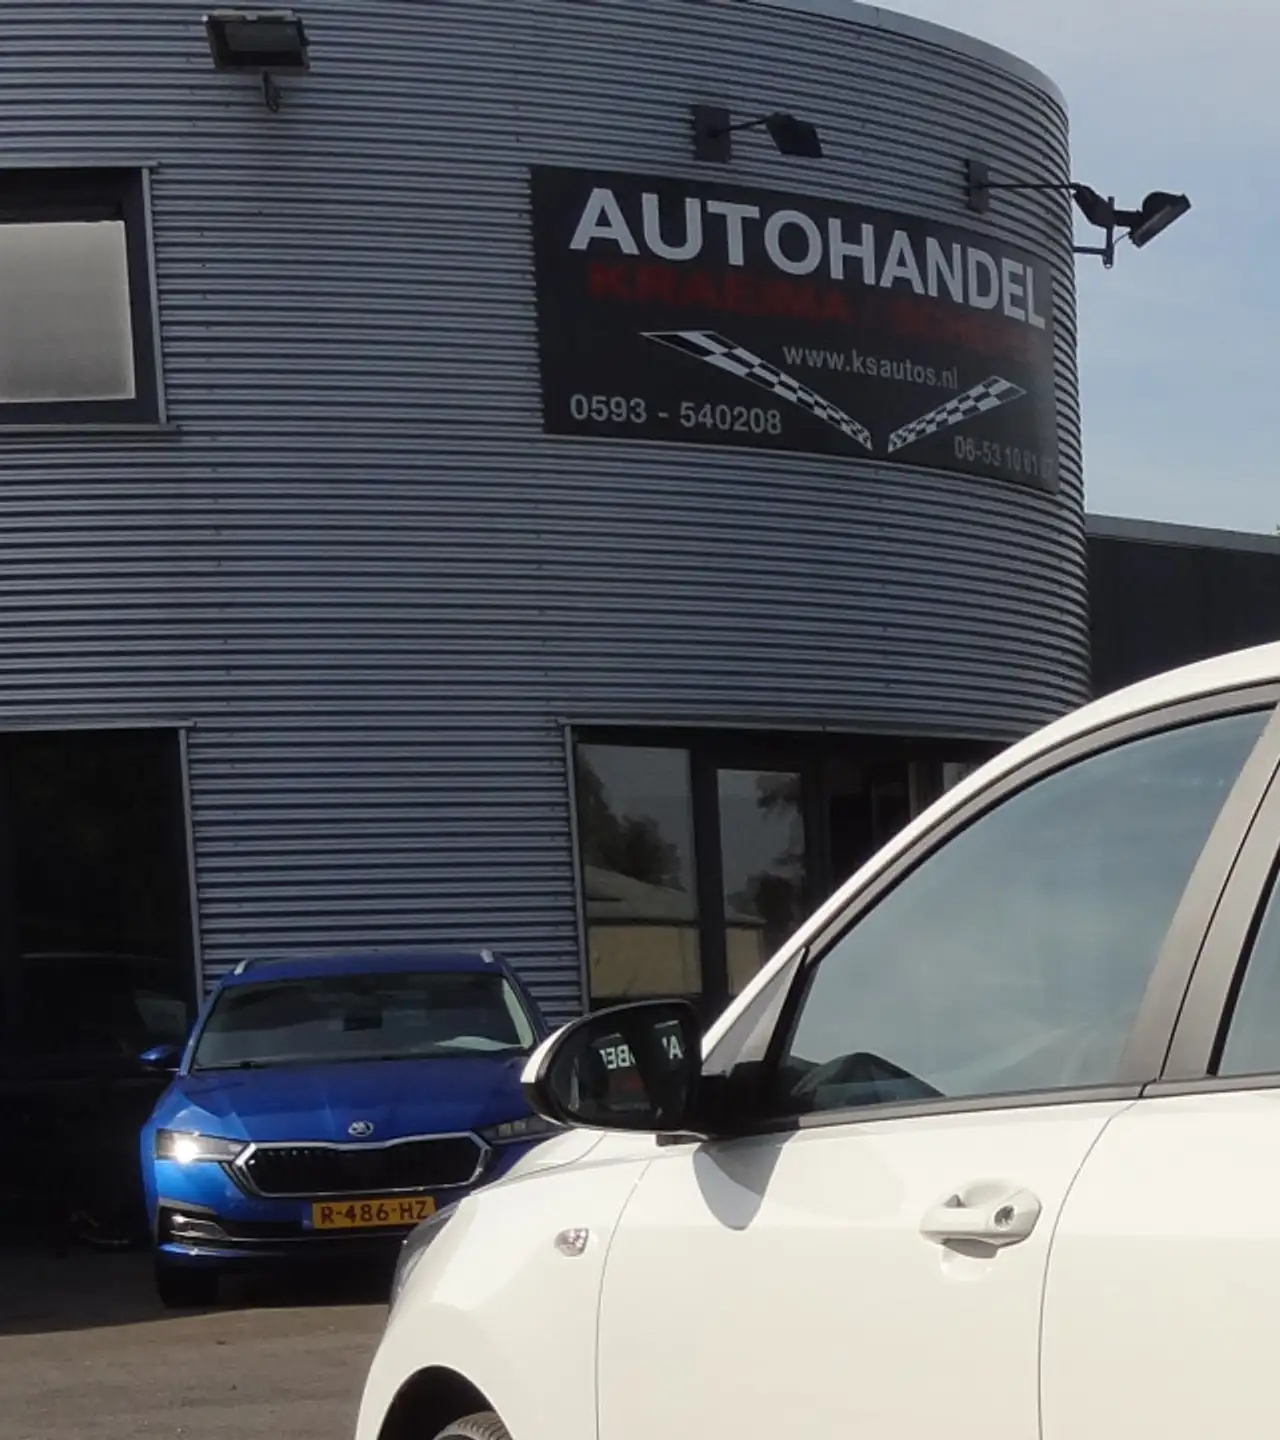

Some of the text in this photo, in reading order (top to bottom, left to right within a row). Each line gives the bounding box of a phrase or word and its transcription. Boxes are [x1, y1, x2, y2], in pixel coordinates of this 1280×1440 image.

[569, 187, 1046, 329] AUTOHANDEL
[782, 344, 958, 390] www.ksautos.nl
[569, 393, 648, 424] 0593
[679, 401, 783, 435] 540208
[953, 435, 1002, 468] 06-53
[320, 1200, 428, 1225] R-486-HZ
